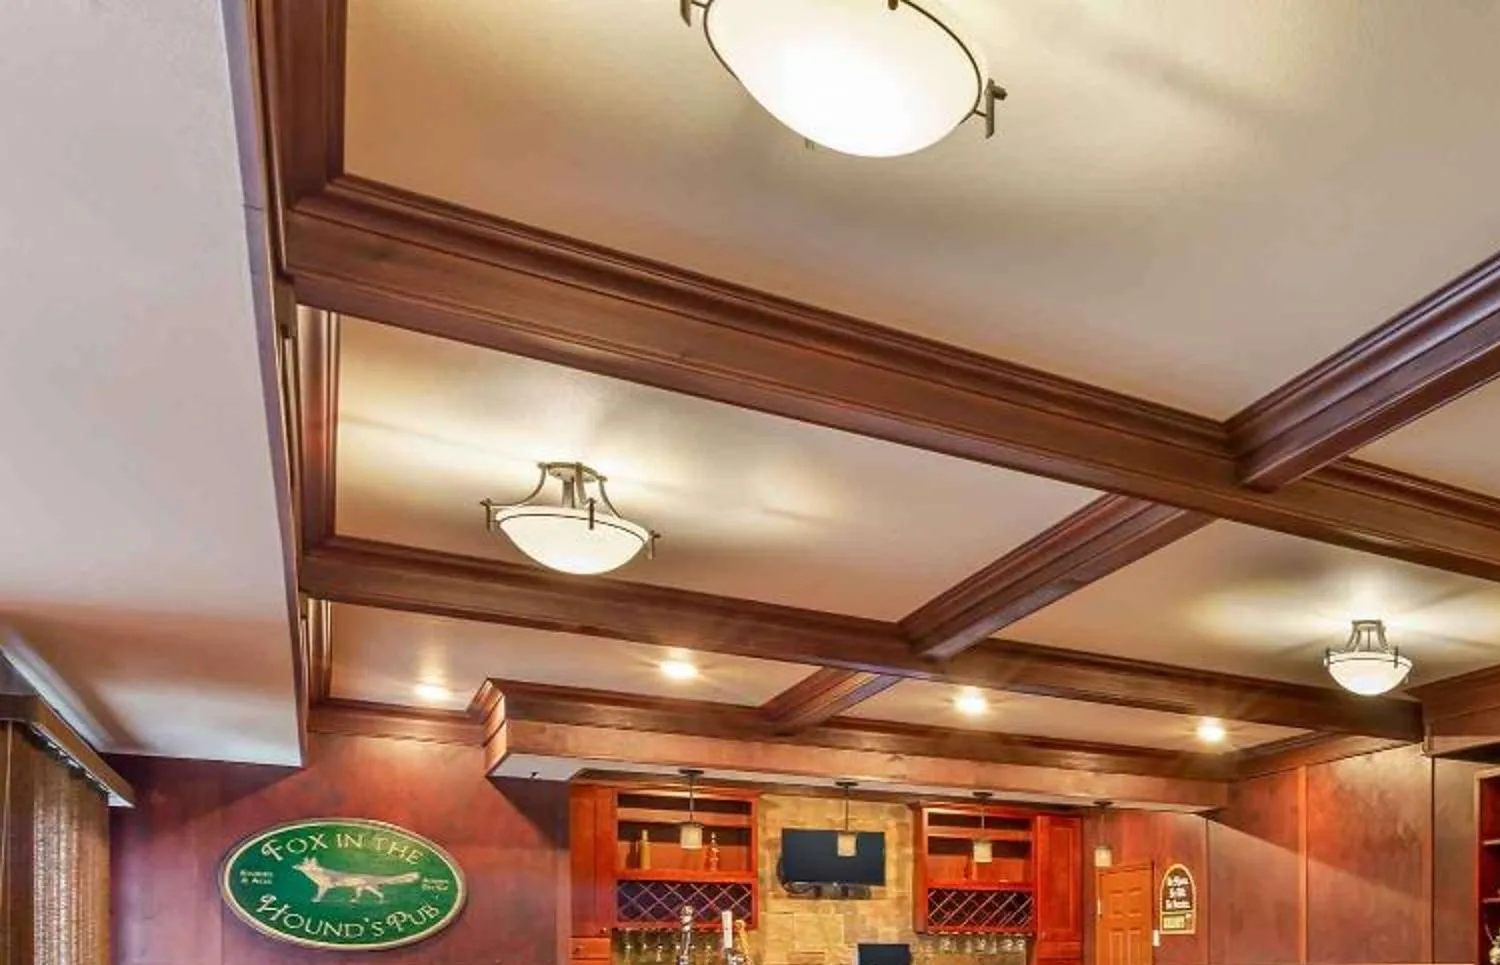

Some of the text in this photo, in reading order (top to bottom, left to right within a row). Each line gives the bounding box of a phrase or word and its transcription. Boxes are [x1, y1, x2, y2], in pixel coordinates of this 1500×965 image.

[335, 833, 365, 849] IN
[375, 837, 425, 865] THE
[386, 903, 441, 932] PUB
